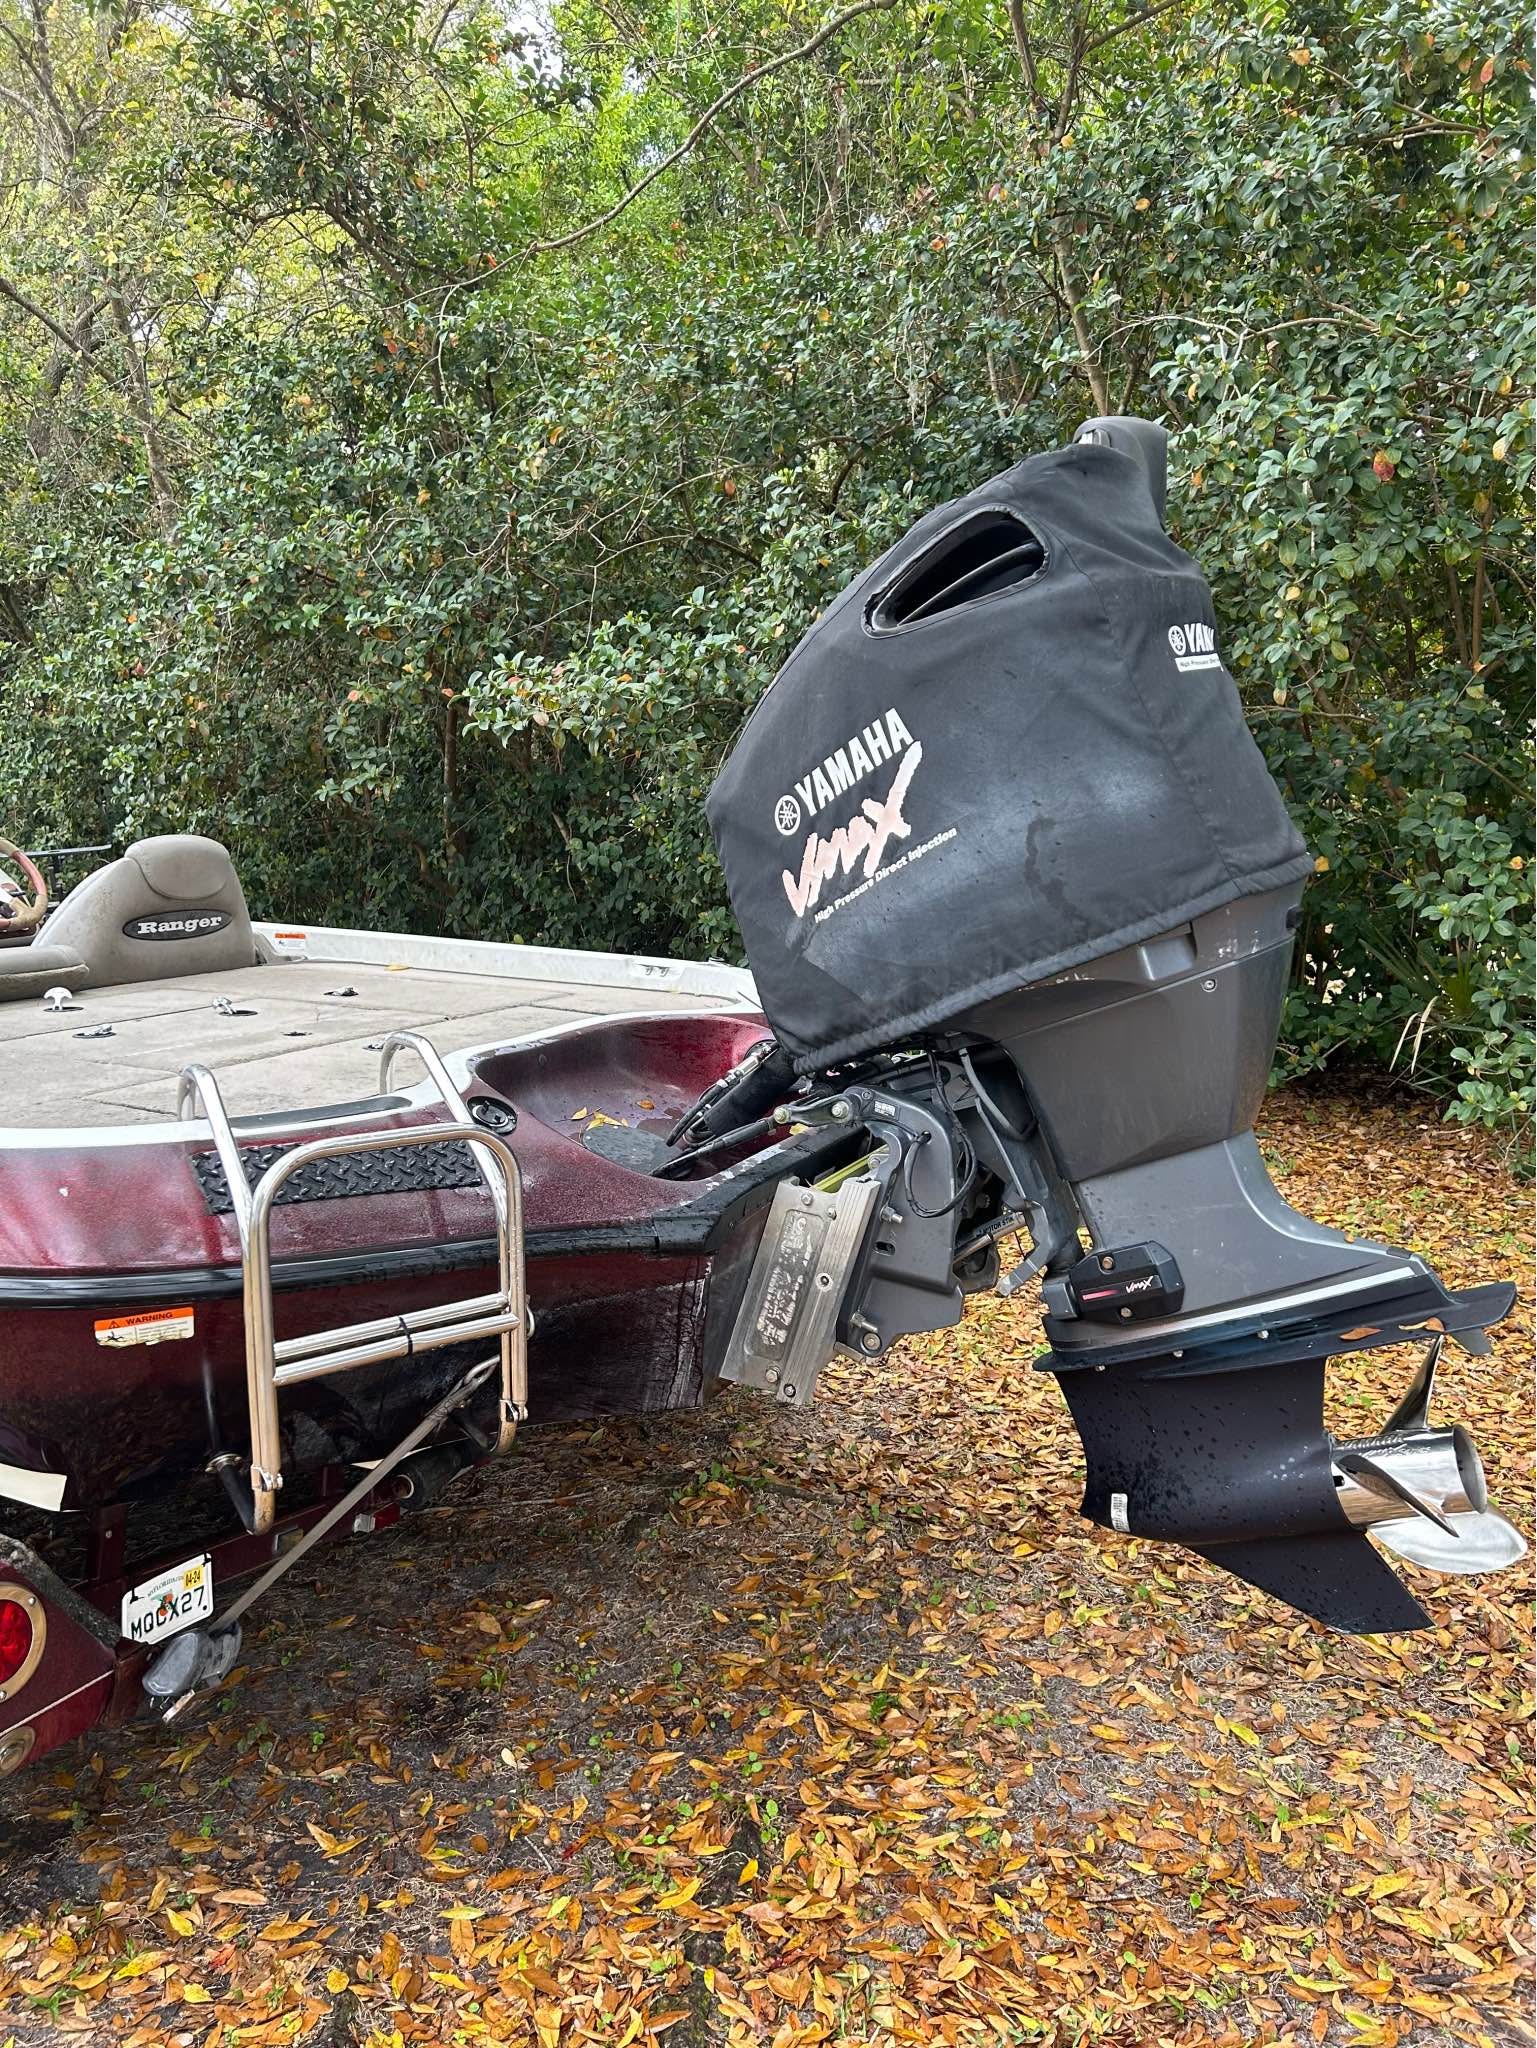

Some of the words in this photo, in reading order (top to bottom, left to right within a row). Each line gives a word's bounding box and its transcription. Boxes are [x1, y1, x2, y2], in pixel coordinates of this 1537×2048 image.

[794, 707, 914, 817] YAMAHA
[814, 904, 835, 923] High
[834, 878, 874, 910] Pressure
[875, 856, 908, 882] Direct
[907, 827, 957, 862] Injection
[137, 916, 222, 934] Ranger
[125, 1311, 173, 1325] WARNING
